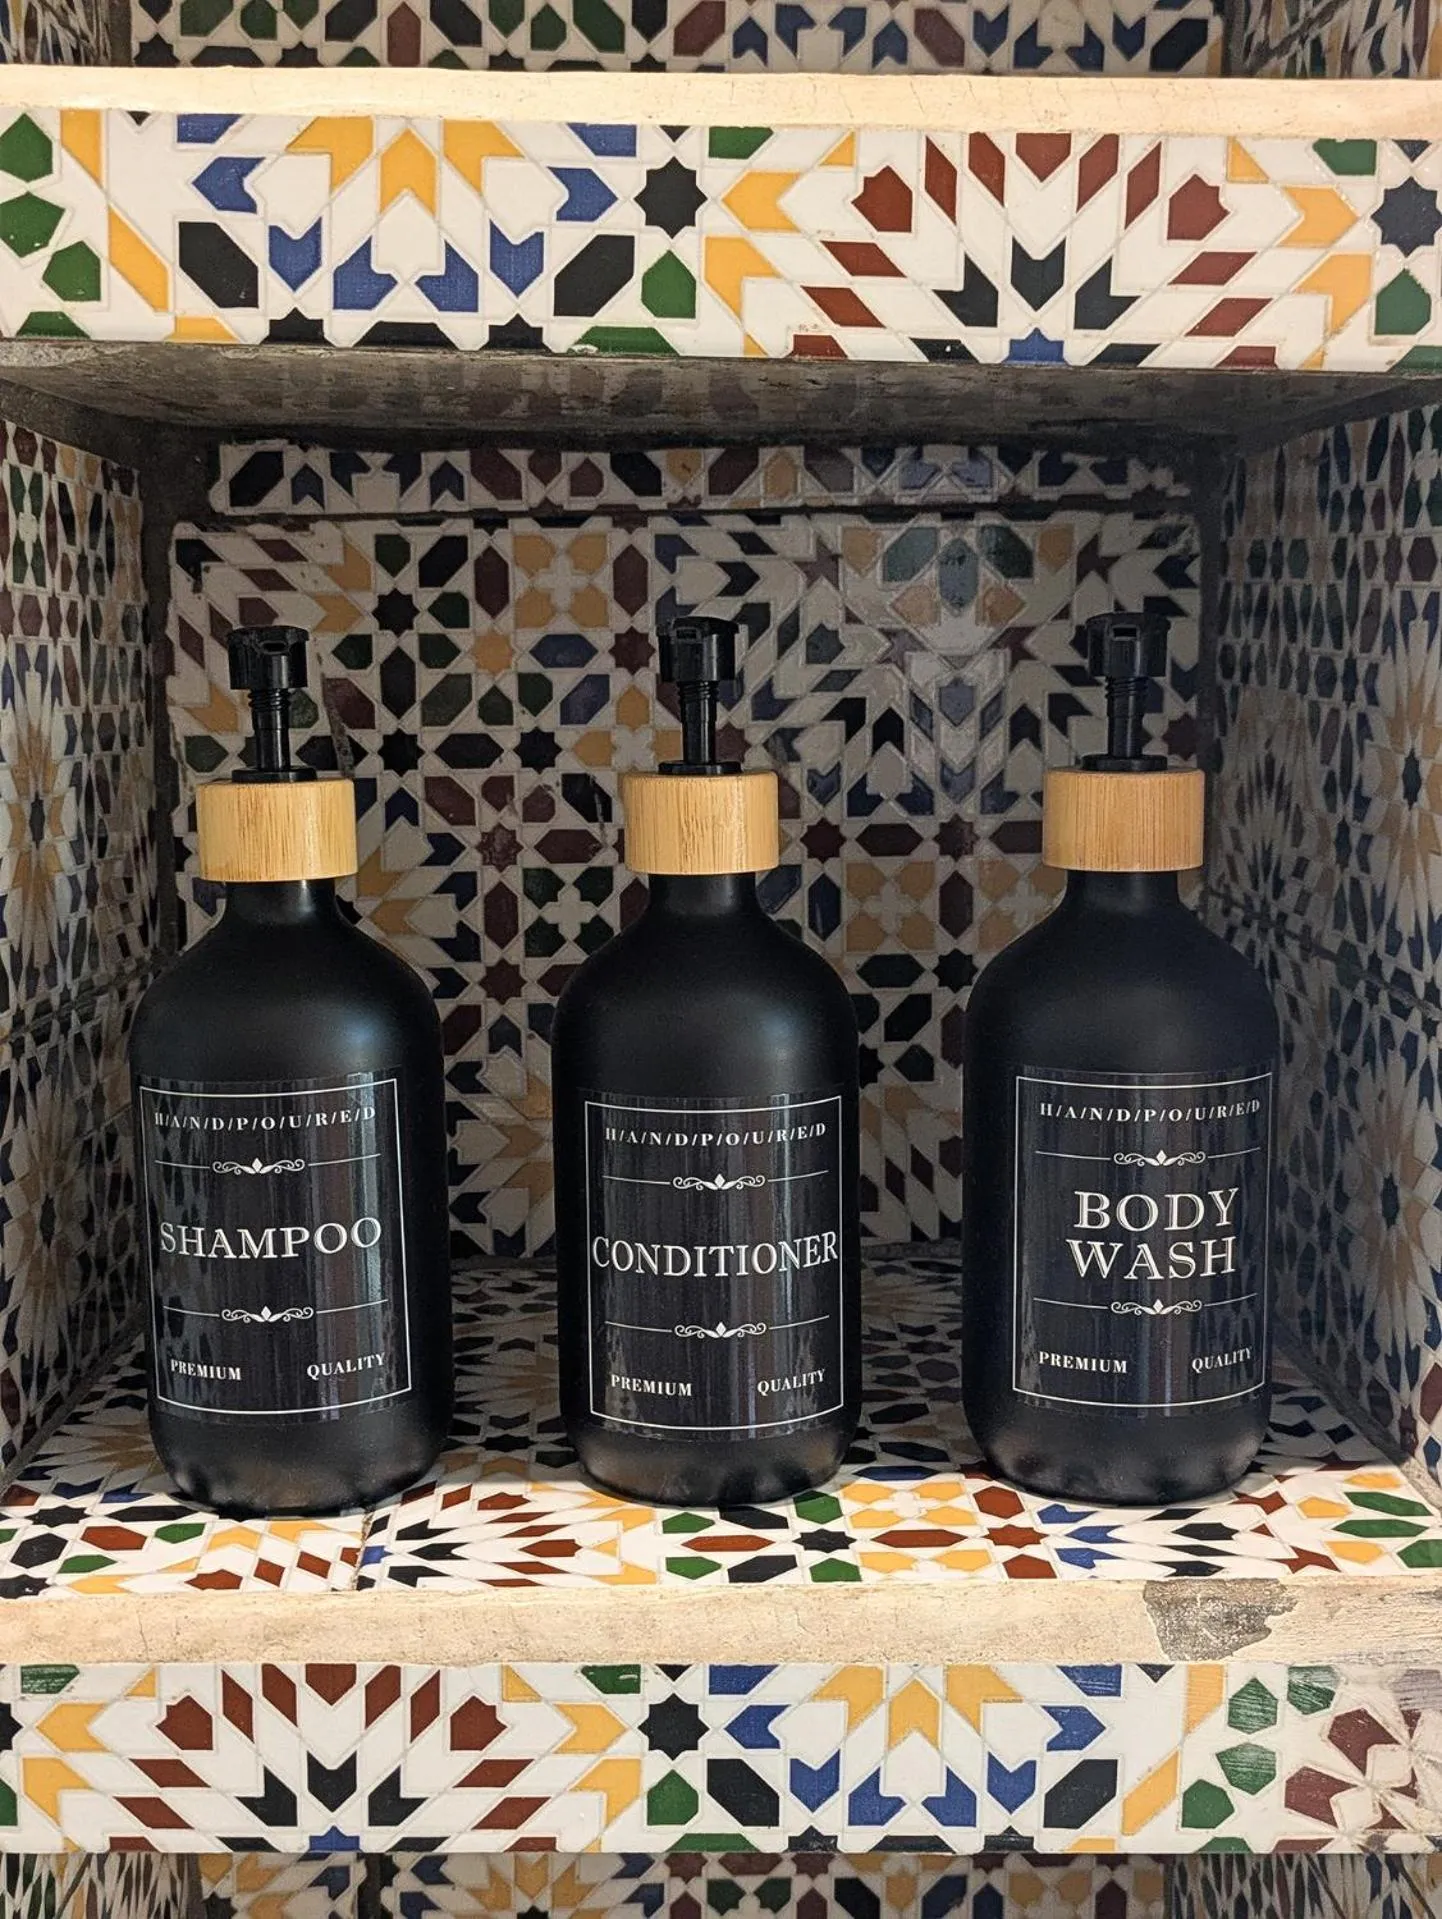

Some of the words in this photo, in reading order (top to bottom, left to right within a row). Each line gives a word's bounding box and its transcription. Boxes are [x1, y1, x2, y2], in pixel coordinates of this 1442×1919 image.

[1074, 1188, 1239, 1231] BODY
[160, 1217, 381, 1259] SHAMPOO
[593, 1231, 838, 1277] CONDITIONER
[1066, 1236, 1236, 1280] WASH
[170, 1359, 241, 1380] PREMIUM
[307, 1352, 385, 1380] QUALITY
[1039, 1351, 1127, 1373] PREMIUM
[1192, 1346, 1252, 1373] QUALITY
[611, 1374, 692, 1396] PREMIUM
[758, 1369, 825, 1395] QUALITY
